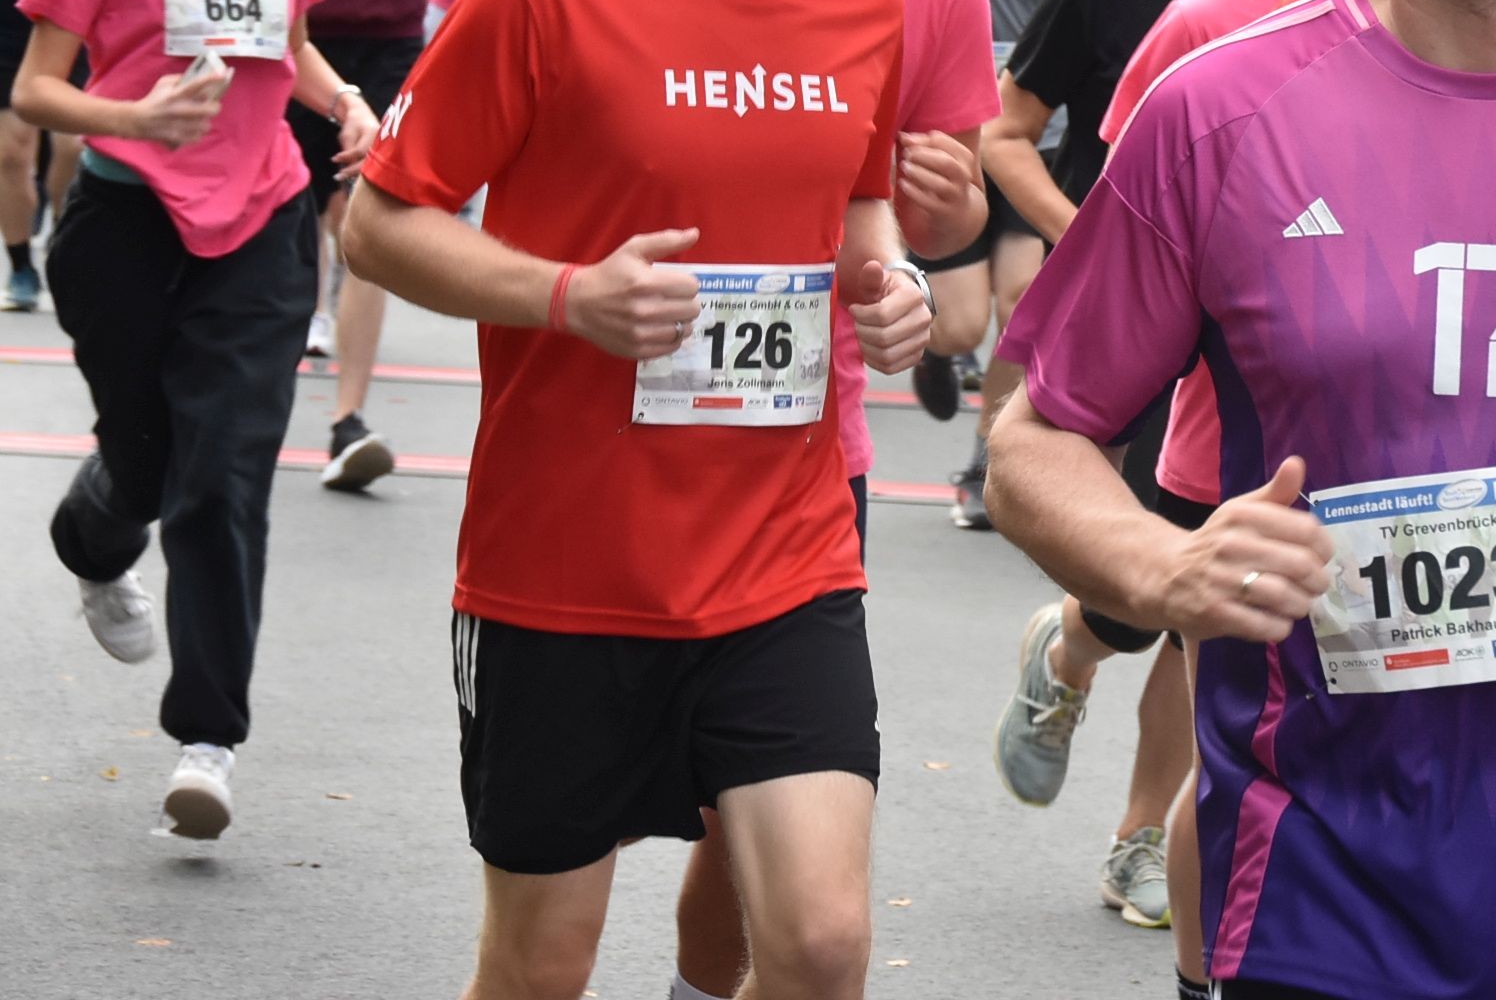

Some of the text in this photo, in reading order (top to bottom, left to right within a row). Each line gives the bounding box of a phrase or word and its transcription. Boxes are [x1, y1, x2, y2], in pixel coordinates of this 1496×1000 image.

[664, 62, 848, 118] HENSEL
[750, 300, 781, 310] GmbH
[704, 321, 793, 370] 126
[1325, 497, 1393, 519] Lennestadt
[1396, 492, 1434, 512] läuft!
[1379, 525, 1399, 539] TV
[1391, 623, 1442, 642] Patrick
[1342, 657, 1379, 669] ONTAVIO
